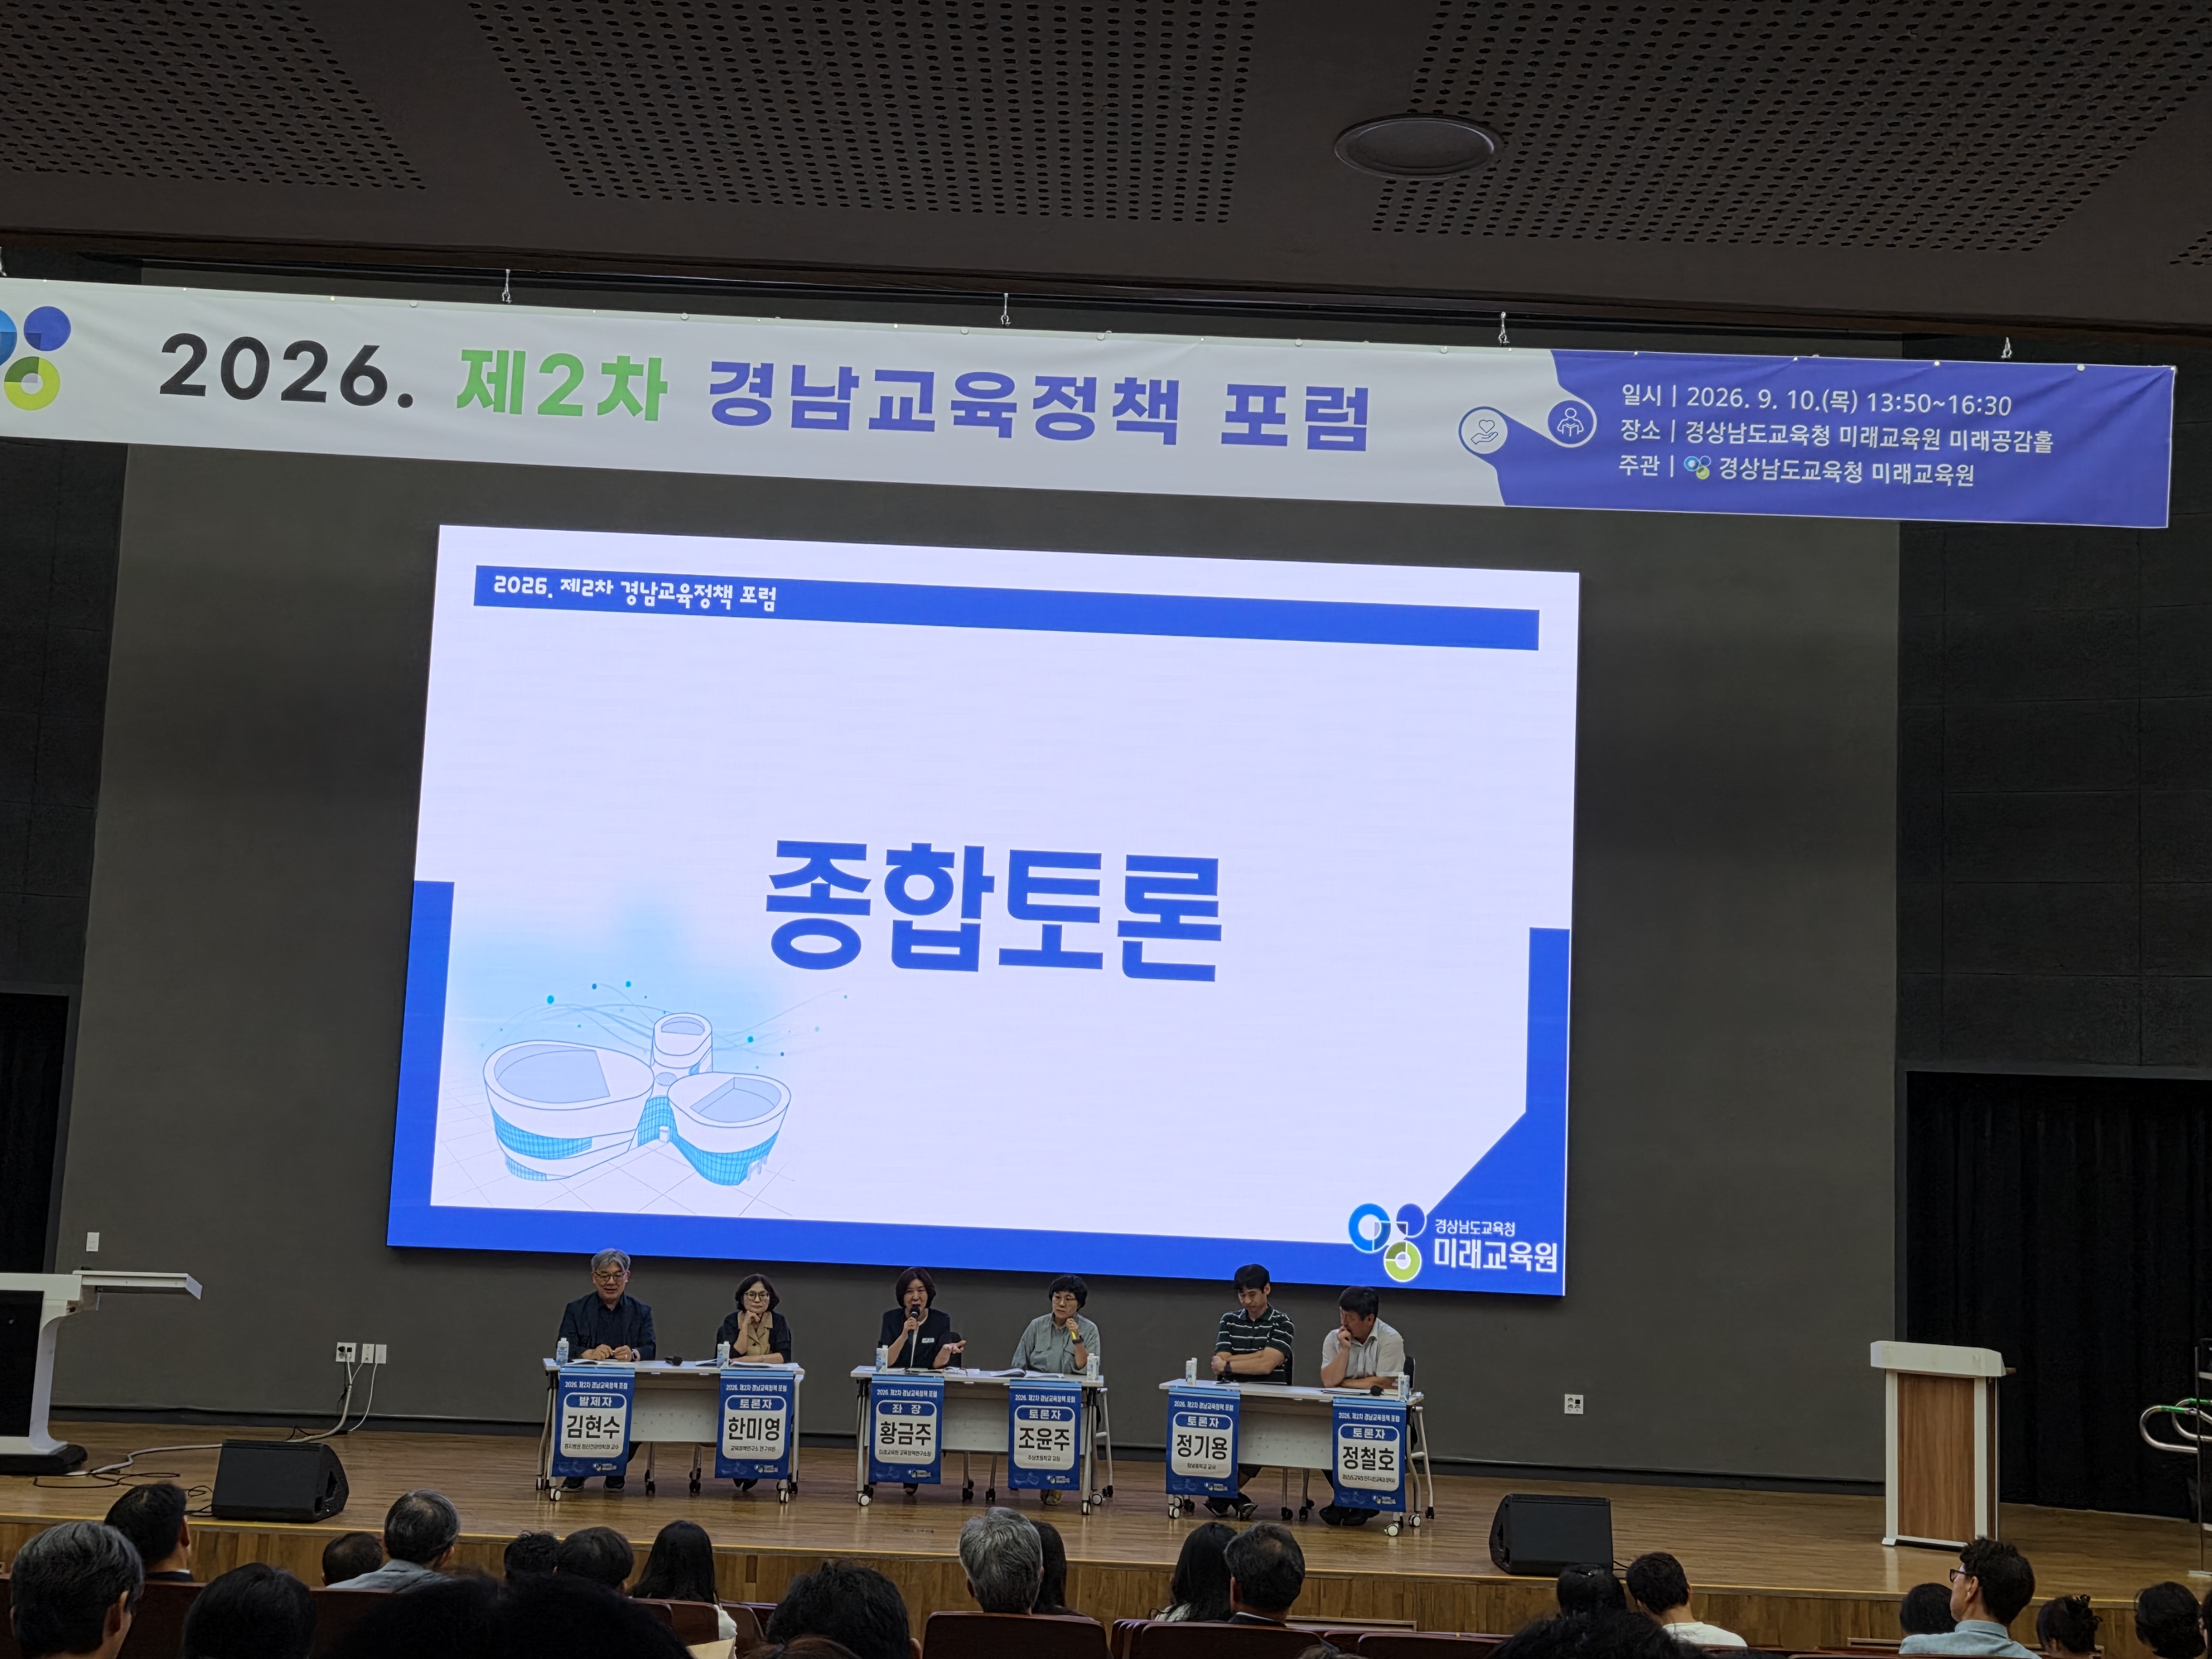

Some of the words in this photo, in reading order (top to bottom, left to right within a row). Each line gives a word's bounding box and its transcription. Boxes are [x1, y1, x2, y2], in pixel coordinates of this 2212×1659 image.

[160, 333, 414, 408] 2026.
[456, 348, 668, 421] 제2차
[709, 361, 1179, 445] 경남교육정책
[1220, 383, 1369, 452] 포럼
[1622, 383, 1661, 407] 일시
[1687, 387, 1749, 408] 2026.
[1758, 390, 1777, 410] 9.
[1789, 388, 1858, 414] 10.(목)
[1867, 393, 2011, 416] 13:50~16:30
[1621, 419, 1661, 441] 장소
[1687, 420, 1829, 446] 경상남도교육청
[1840, 425, 1940, 449] 미래교육원
[1950, 429, 2053, 454] 미래공감홀
[1619, 455, 1661, 477] 주관
[1720, 457, 1862, 483] 경상남도교육청
[1872, 462, 1974, 487] 미래교육원
[494, 575, 552, 598] 2026.
[560, 578, 613, 597] 제2차
[621, 581, 733, 609] 경남교육정책
[740, 586, 776, 612] 포럼
[766, 840, 1222, 982] 종합토론
[1435, 1219, 1515, 1237] 경상남도교육청
[1434, 1239, 1557, 1272] 미래교육원
[580, 1396, 612, 1407] 발제자
[739, 1399, 772, 1409] 토론자
[567, 1415, 619, 1438] 김현수
[1029, 1409, 1061, 1420] 토론자
[1187, 1416, 1219, 1428] 토론자
[729, 1417, 780, 1441] 한미영
[880, 1421, 931, 1446] 황금주
[1019, 1427, 1070, 1451] 조윤주
[1353, 1427, 1385, 1439] 토론자
[1177, 1434, 1228, 1460] 정기용
[1343, 1446, 1394, 1471] 정철호
